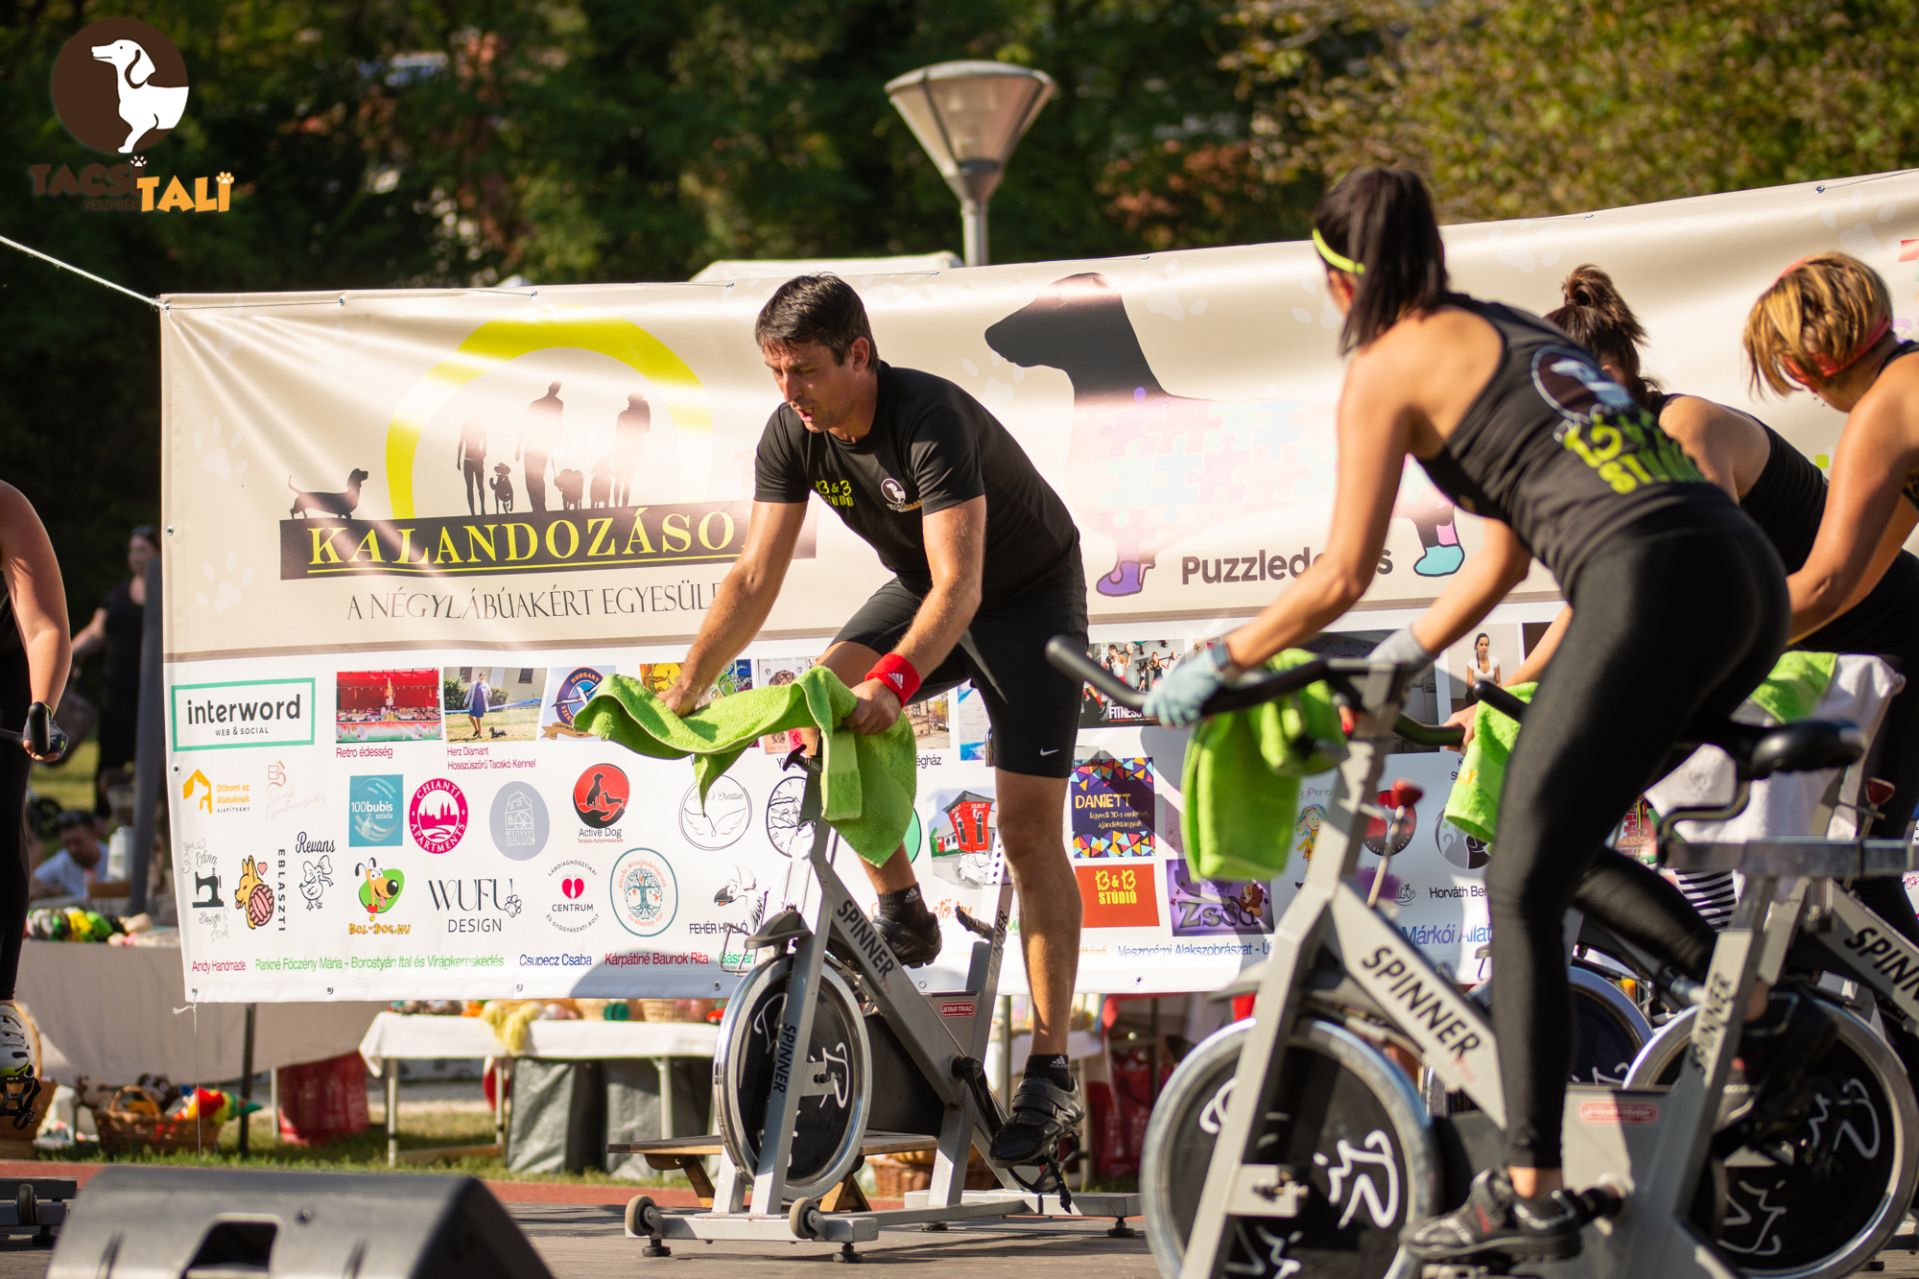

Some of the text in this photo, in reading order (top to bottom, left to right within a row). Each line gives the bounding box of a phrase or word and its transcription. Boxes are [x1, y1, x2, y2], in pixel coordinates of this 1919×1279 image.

[308, 508, 747, 566] KALANDOZÁSO
[1181, 546, 1394, 585] Puzzleds
[347, 594, 363, 621] A
[370, 584, 595, 621] NÉGYLÁBÚAKÉRT
[187, 694, 301, 725] interword
[215, 726, 270, 737] WEB & SOCIAL
[336, 746, 393, 760] Retro édesség
[915, 754, 943, 770] égház
[416, 780, 461, 800] CHIANTI
[351, 800, 393, 812] 100bubis
[411, 822, 466, 853] APARTMENTS
[579, 828, 622, 839] Active Dog
[295, 831, 336, 854] Revans
[1111, 874, 1120, 888] &
[277, 849, 286, 931] EBLASZTI
[428, 878, 514, 912] WUFU
[1429, 886, 1469, 899] Horváth
[551, 903, 594, 912] CENTRUM
[448, 918, 503, 933] DESIGN
[689, 920, 718, 935] FEHÉR
[836, 900, 895, 977] SPINNER
[1400, 923, 1456, 945] Márkói
[192, 959, 247, 975] Andy Handmade
[350, 956, 396, 970] Borostyán
[413, 956, 425, 968] és
[519, 953, 592, 969] Csupecz Csaba
[604, 952, 709, 968] Kárpátiné Baunok Rita
[1362, 946, 1480, 1060] SPINNER
[772, 1022, 797, 1094] SPINNER
